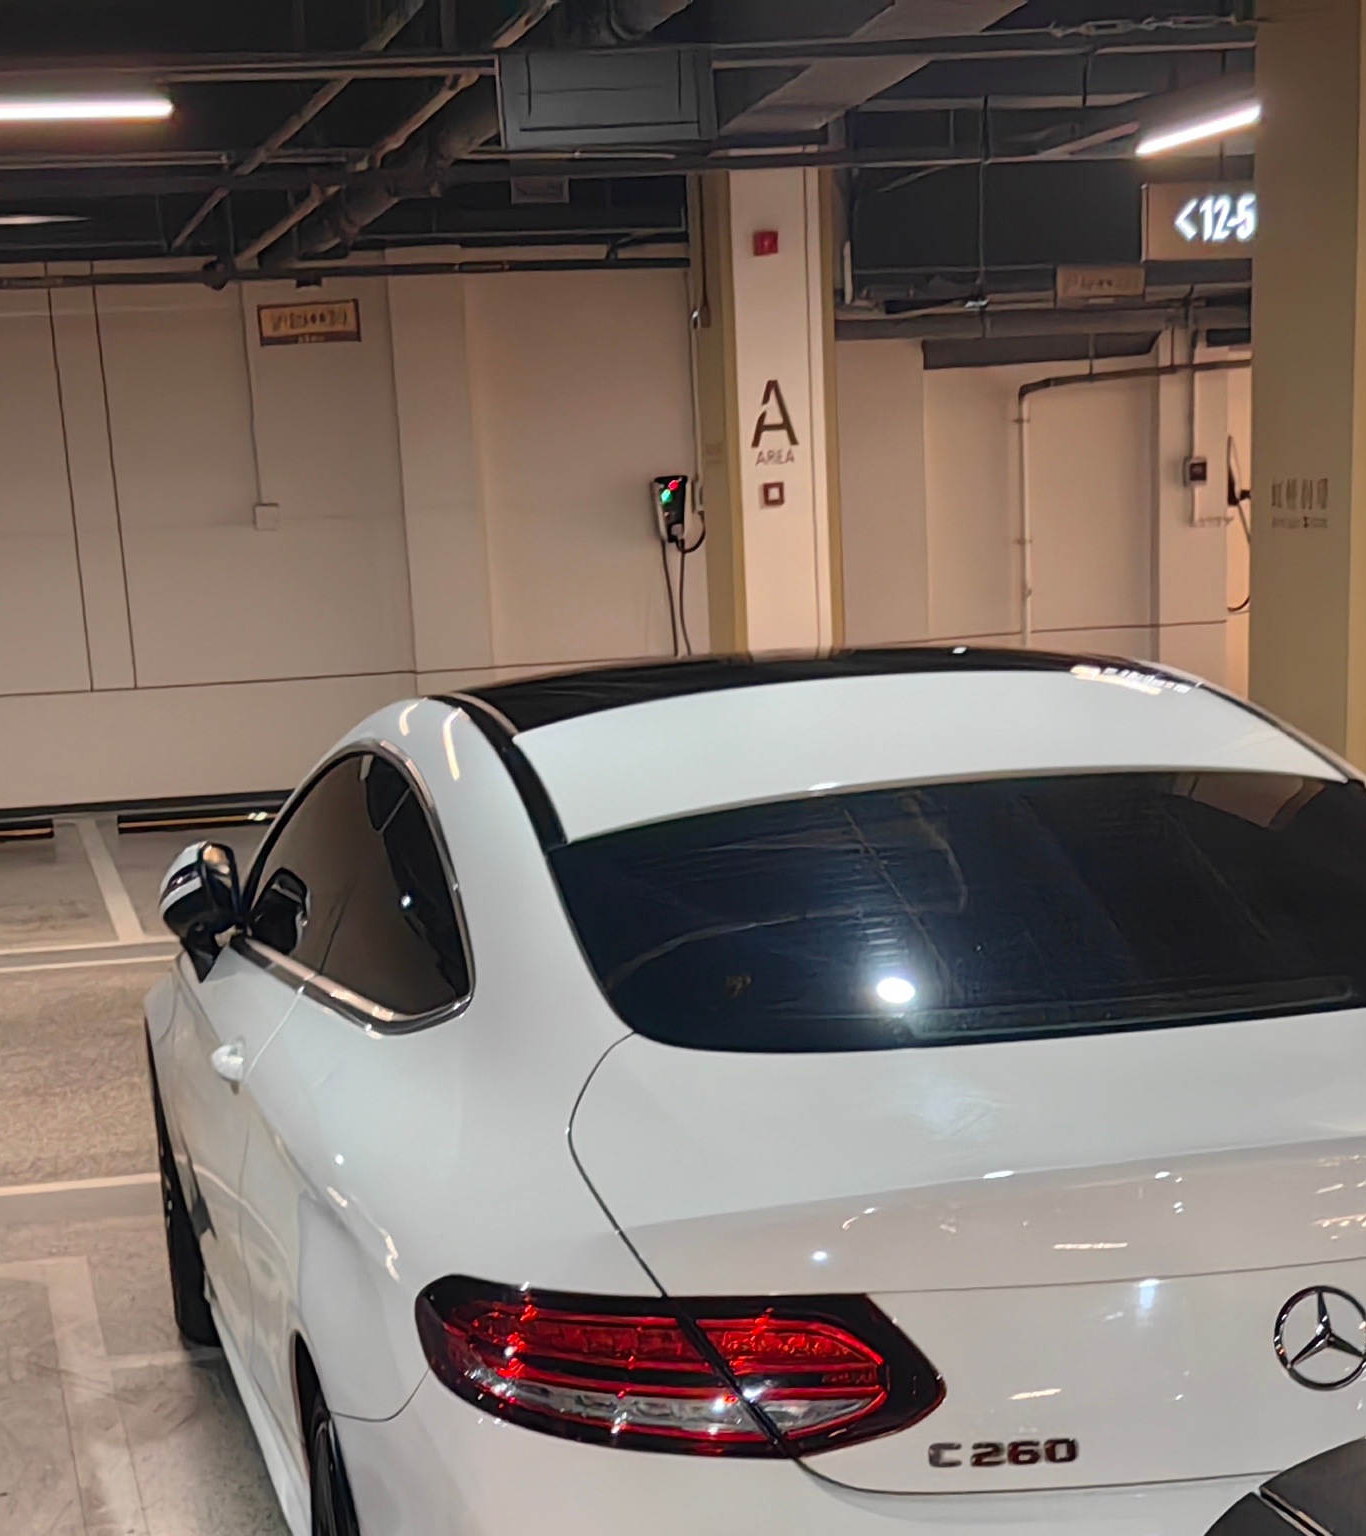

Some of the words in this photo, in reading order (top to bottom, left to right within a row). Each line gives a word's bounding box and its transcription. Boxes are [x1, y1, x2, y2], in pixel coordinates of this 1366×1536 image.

[751, 379, 799, 448] A
[755, 449, 795, 466] AREA
[928, 1442, 962, 1468] C
[970, 1438, 1079, 1467] 260
